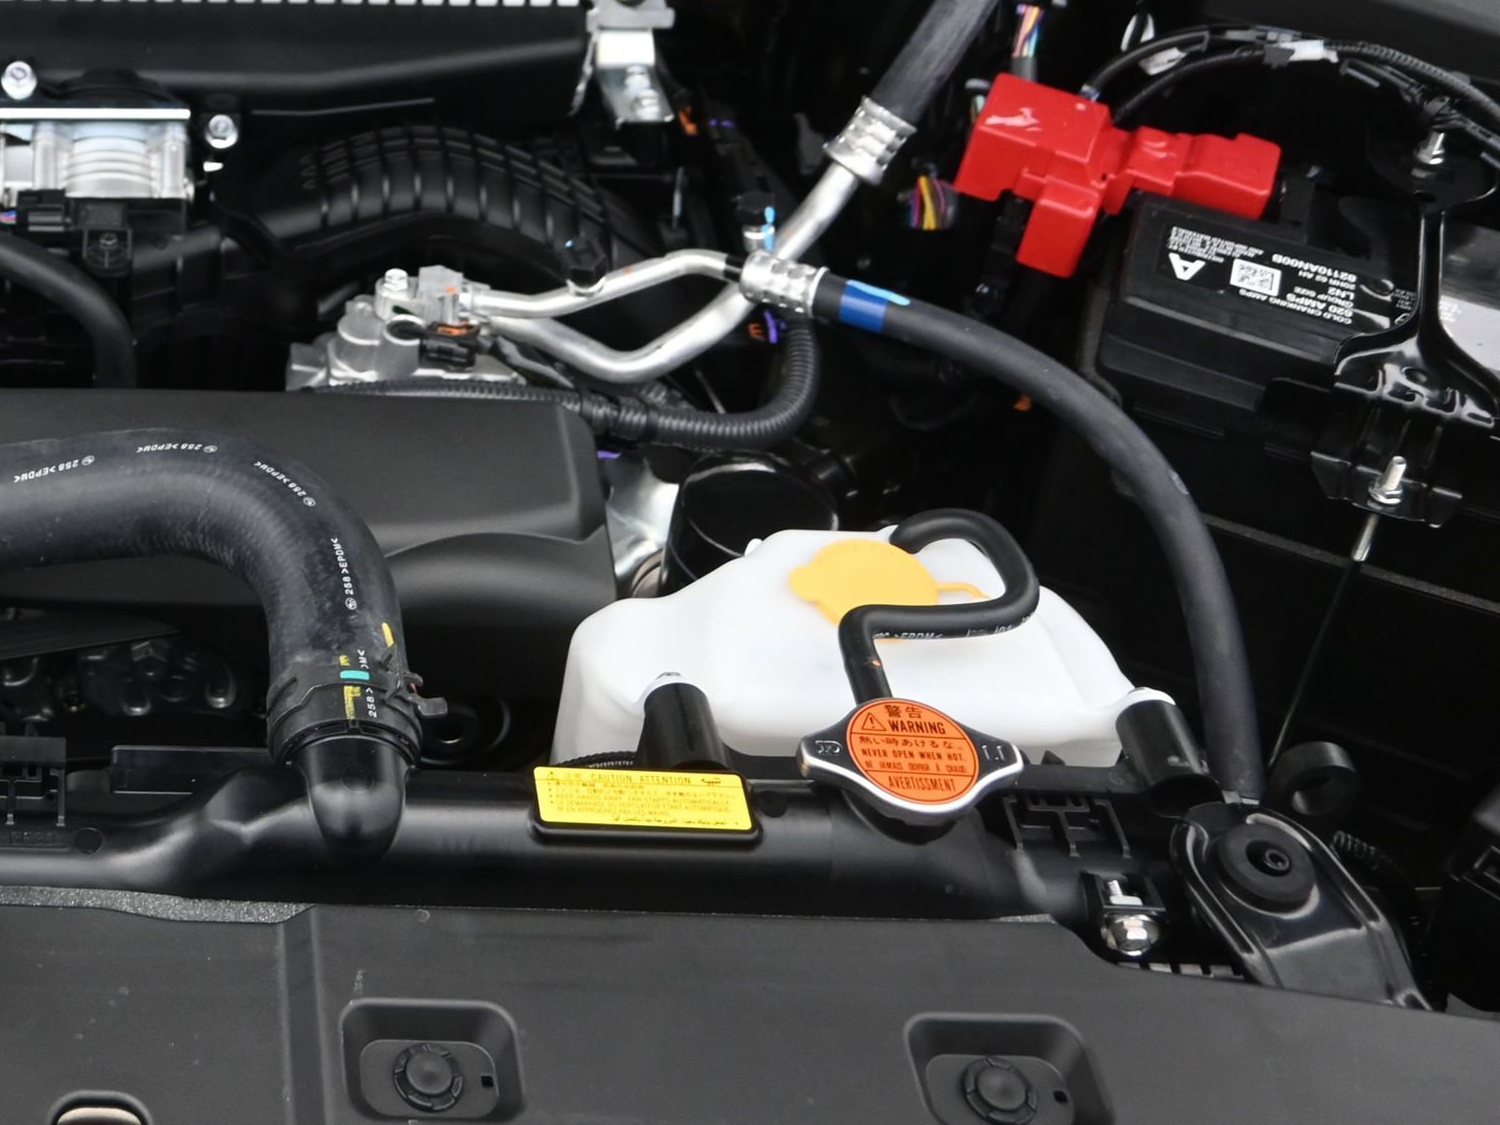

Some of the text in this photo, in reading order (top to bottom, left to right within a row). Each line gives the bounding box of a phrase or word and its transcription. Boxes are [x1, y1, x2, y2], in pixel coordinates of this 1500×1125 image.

[1293, 286, 1354, 308] GROUP SIZE
[1327, 286, 1354, 300] LN2
[1239, 288, 1352, 325] COLD CRANKING AMPS
[1286, 293, 1353, 317] 620 AMPS
[58, 459, 79, 472] 258
[342, 576, 354, 595] 258
[884, 704, 922, 719] 警告
[888, 720, 946, 735] WARNING
[861, 748, 967, 762] NEVER OPEN WHEN HOT.
[865, 760, 873, 769] NE
[880, 761, 903, 770] JAMAIS
[591, 773, 632, 781] CAUTION
[640, 775, 691, 785] ATTENTION
[888, 776, 956, 792] AVERTISSMENT
